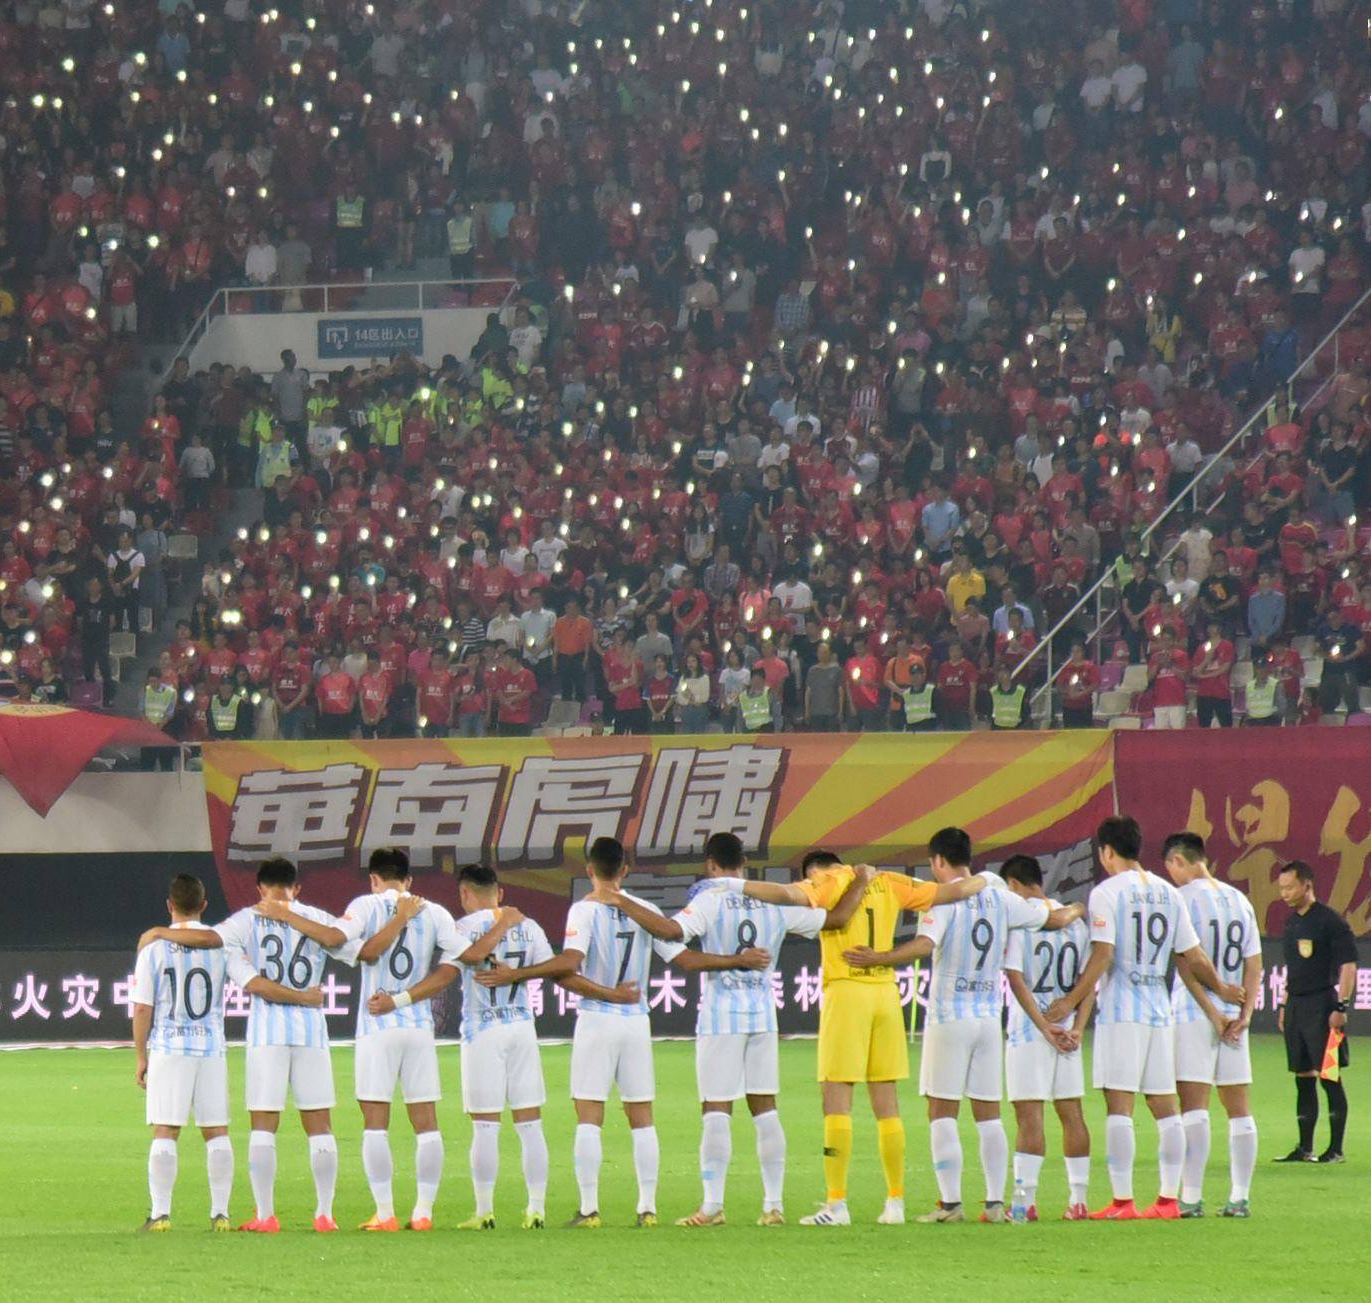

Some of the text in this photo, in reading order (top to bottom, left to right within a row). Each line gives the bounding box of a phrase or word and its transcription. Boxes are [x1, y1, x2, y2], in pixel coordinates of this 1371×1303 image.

[355, 328, 419, 341] 14区出入口
[227, 743, 786, 870] 華南虎嘯
[389, 926, 414, 981] 6
[734, 918, 758, 971] 8
[866, 908, 876, 951] 1
[971, 918, 995, 971] 9
[1131, 912, 1169, 965] 19
[1209, 919, 1245, 972] 18
[259, 934, 312, 989] 36
[484, 950, 527, 1007] 17
[616, 931, 636, 984] 7
[1032, 940, 1080, 993] 20
[164, 967, 213, 1021] 10
